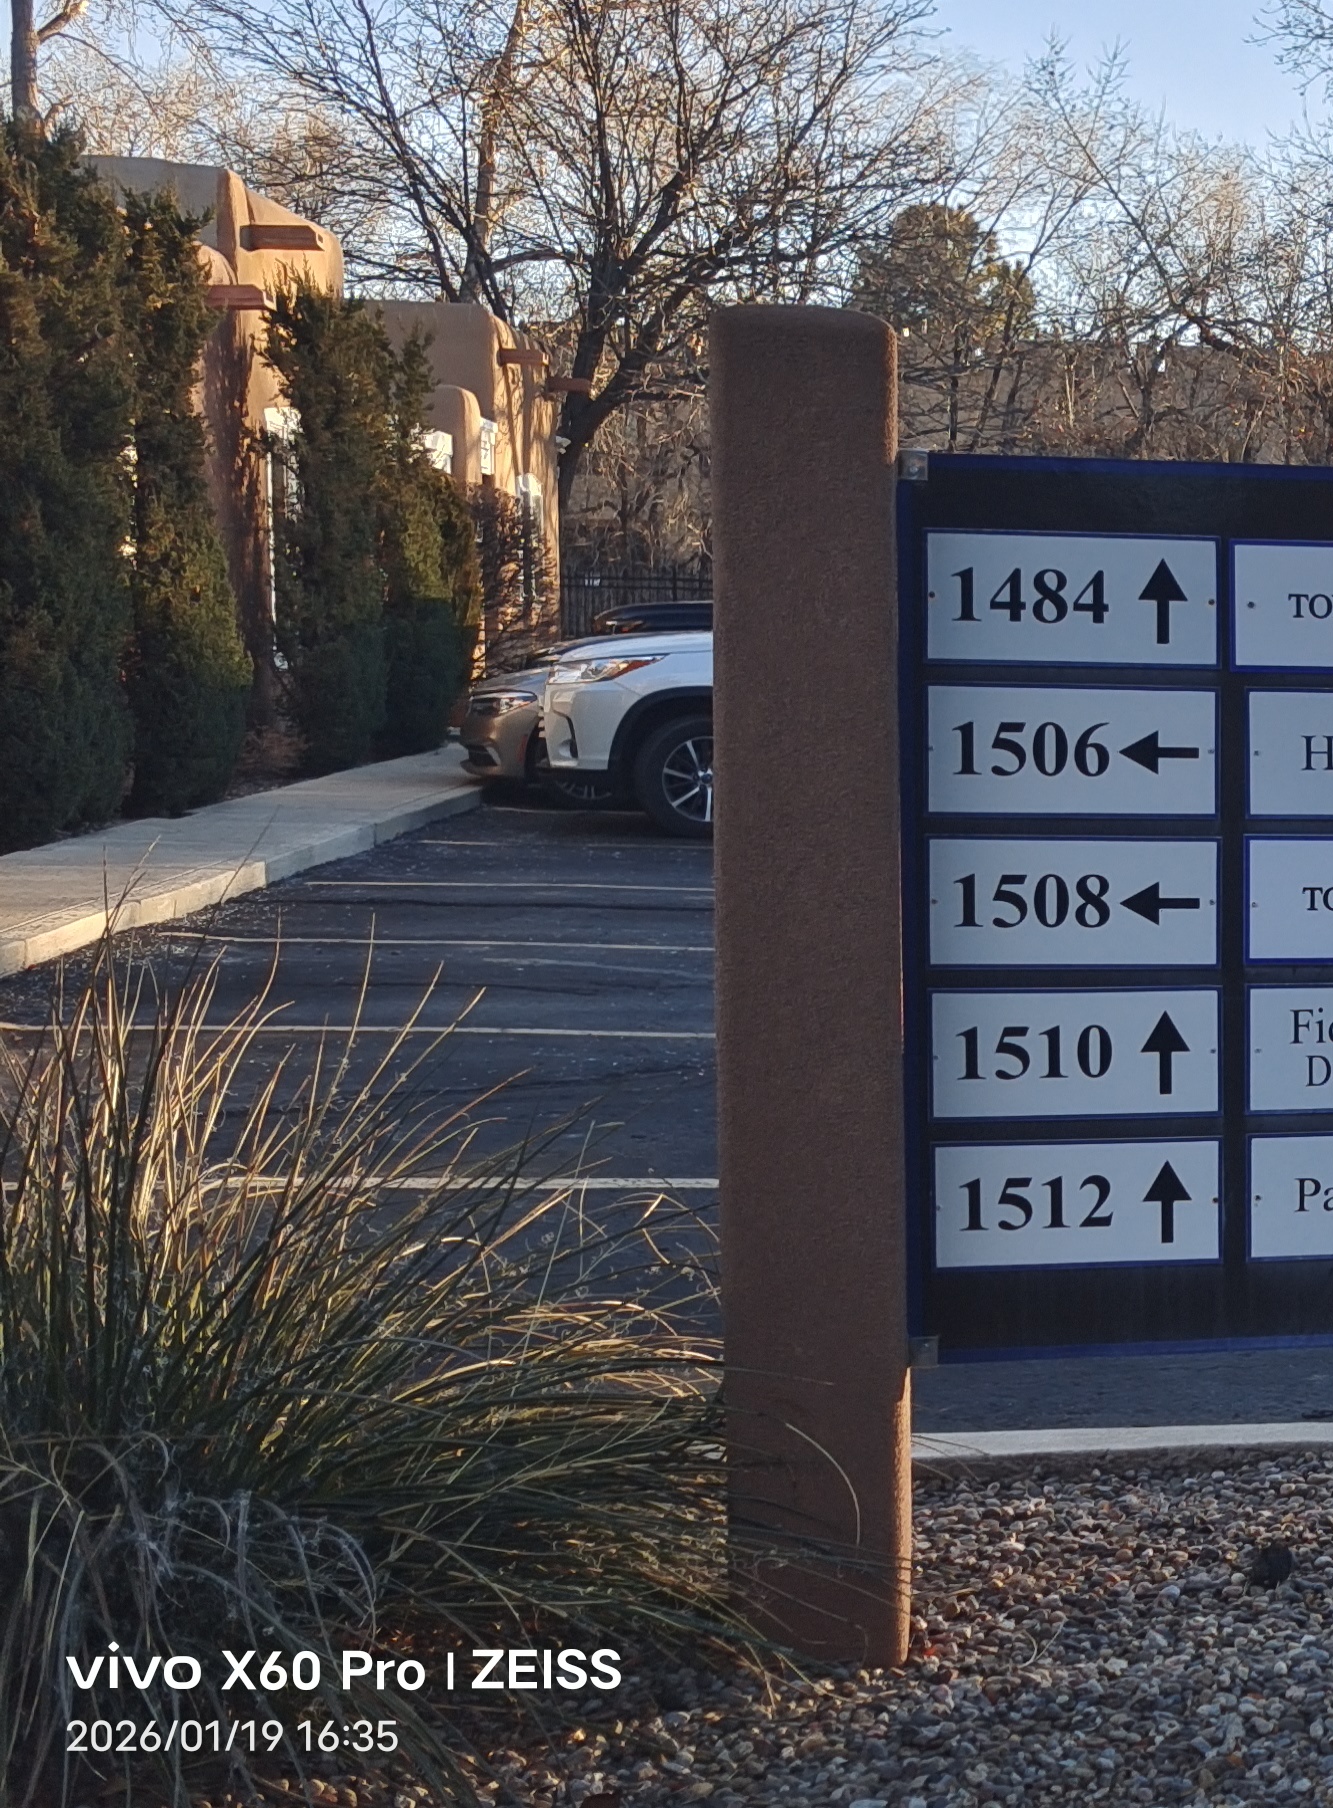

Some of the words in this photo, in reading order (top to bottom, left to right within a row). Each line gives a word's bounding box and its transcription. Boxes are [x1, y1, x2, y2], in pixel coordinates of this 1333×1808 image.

[951, 567, 1109, 624] 1484
[951, 720, 1110, 777] 1506
[953, 873, 1111, 929] 1508
[955, 1024, 1113, 1081] 1510
[959, 1174, 1114, 1232] 1512
